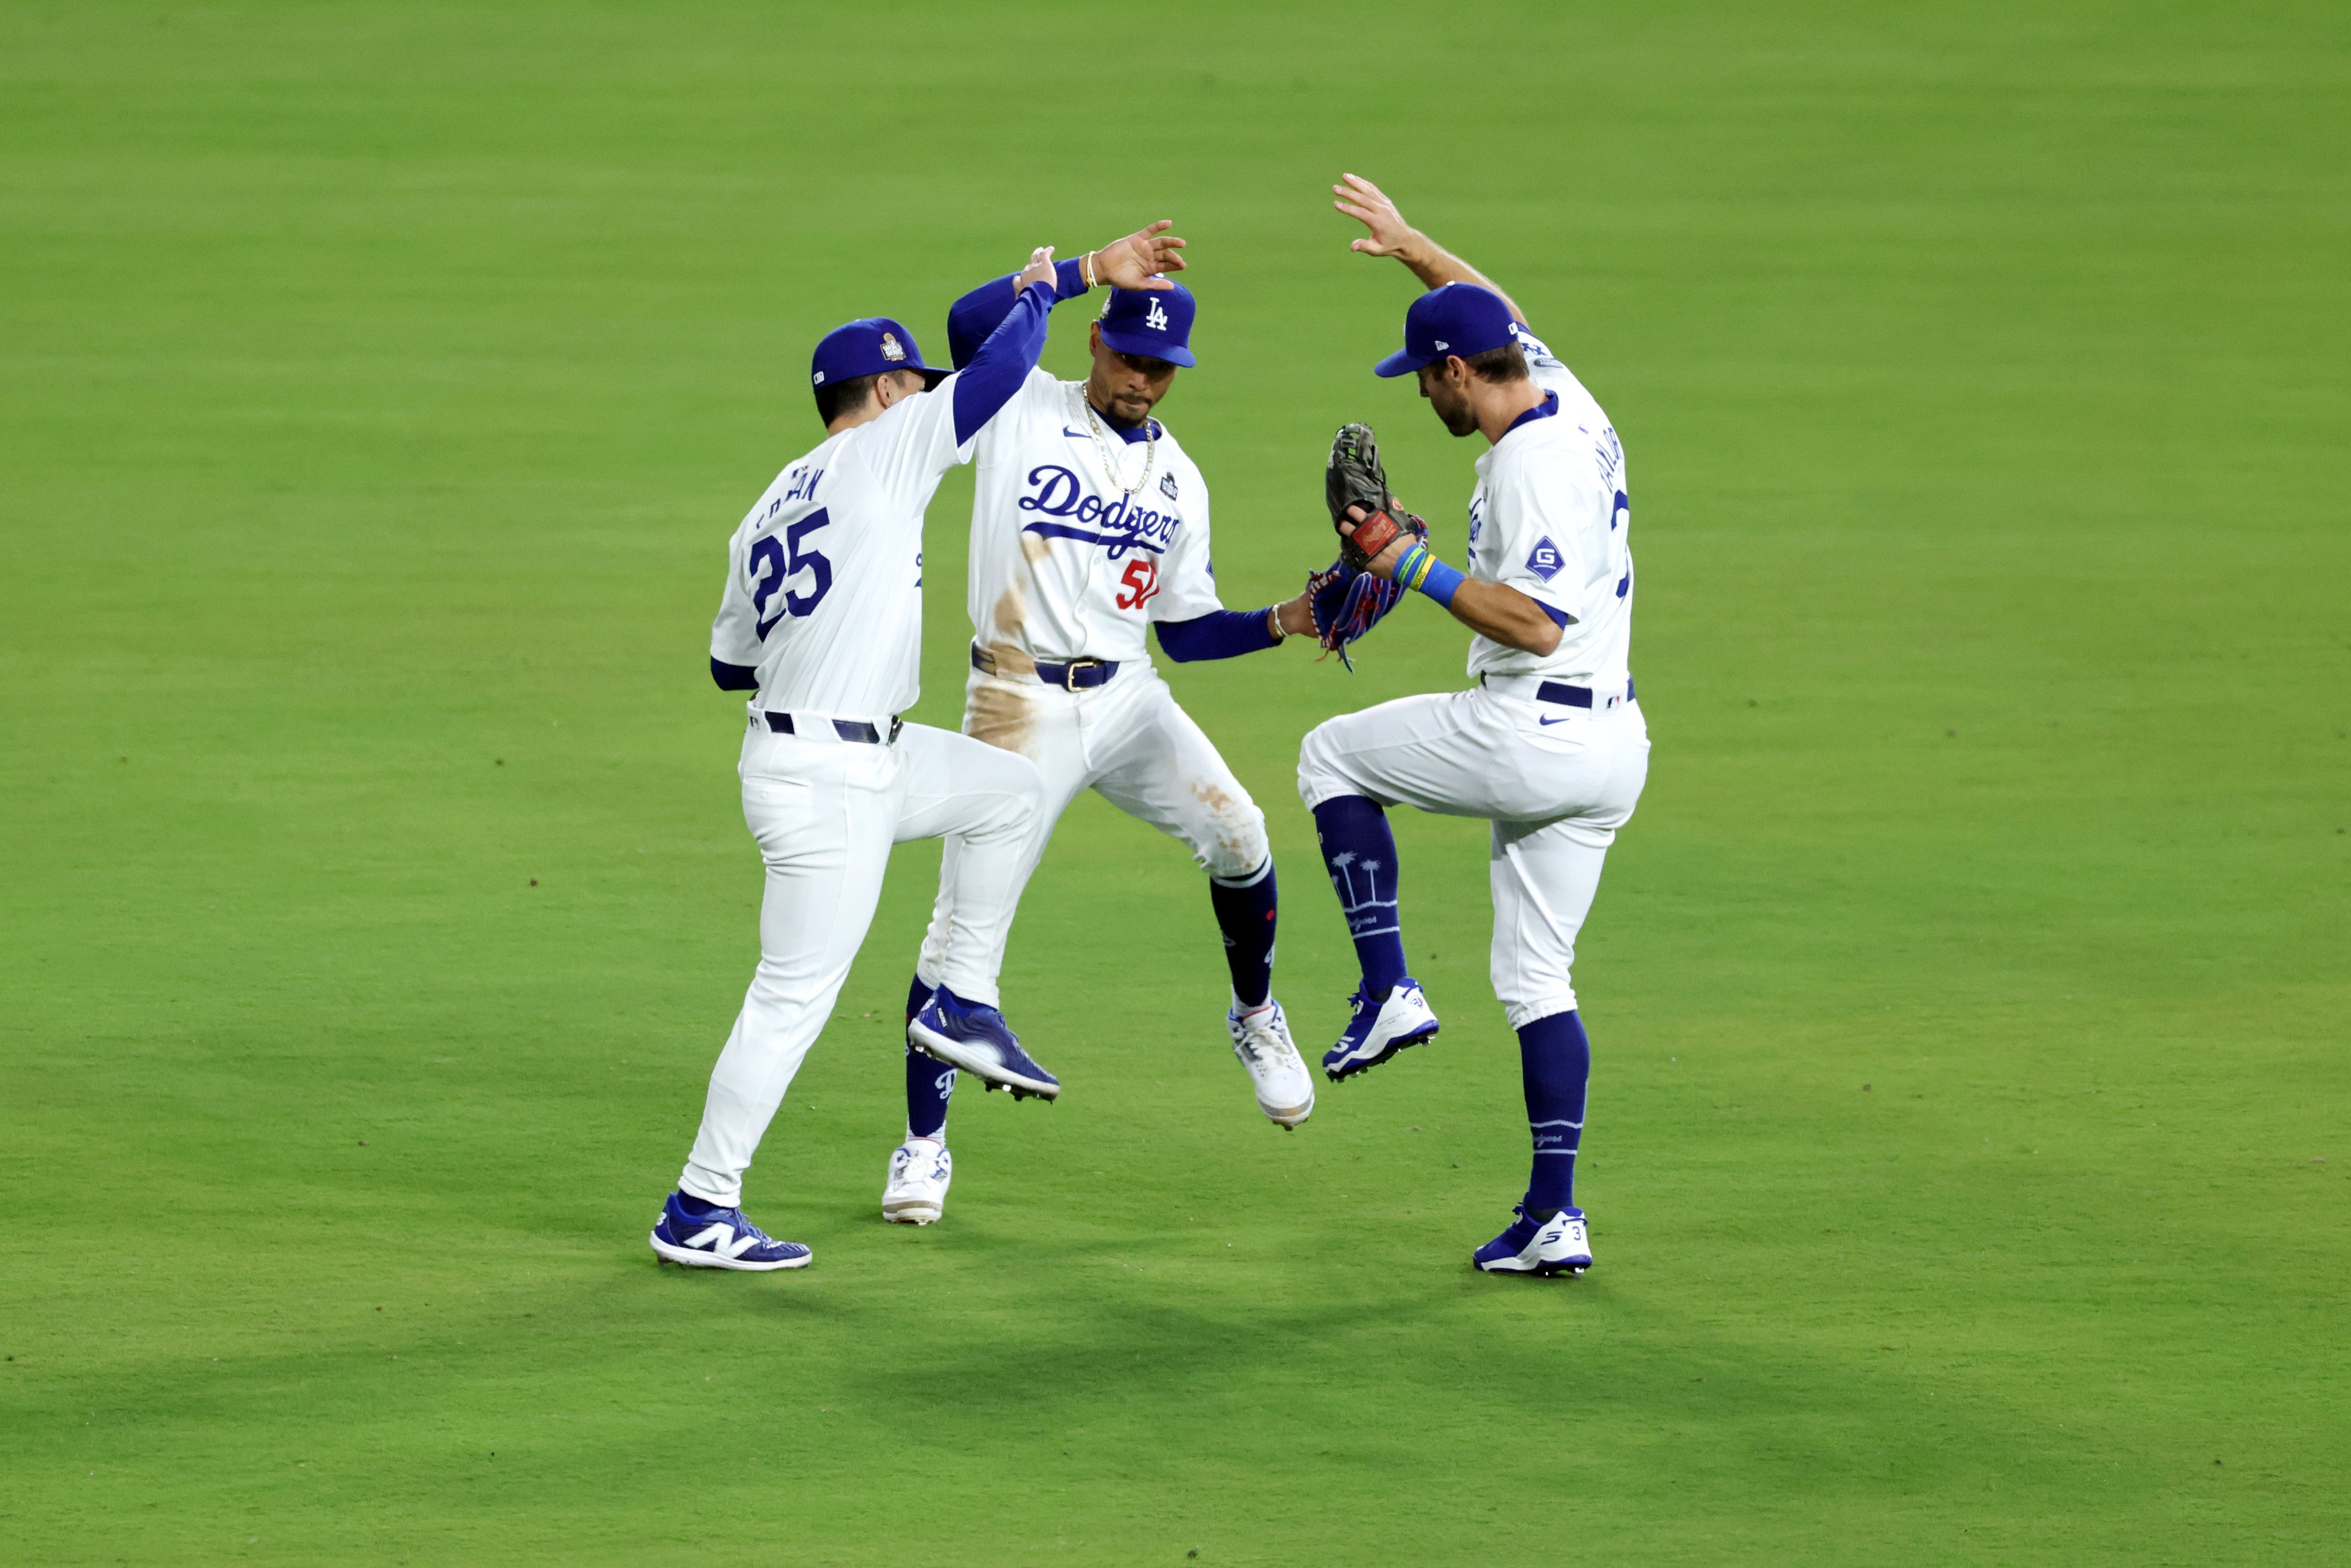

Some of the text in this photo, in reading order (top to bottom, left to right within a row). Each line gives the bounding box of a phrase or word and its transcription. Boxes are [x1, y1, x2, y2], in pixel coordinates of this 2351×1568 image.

[1146, 297, 1168, 331] LA
[1536, 548, 1555, 564] G
[750, 506, 832, 643] 25
[1572, 1226, 1581, 1241] 3
